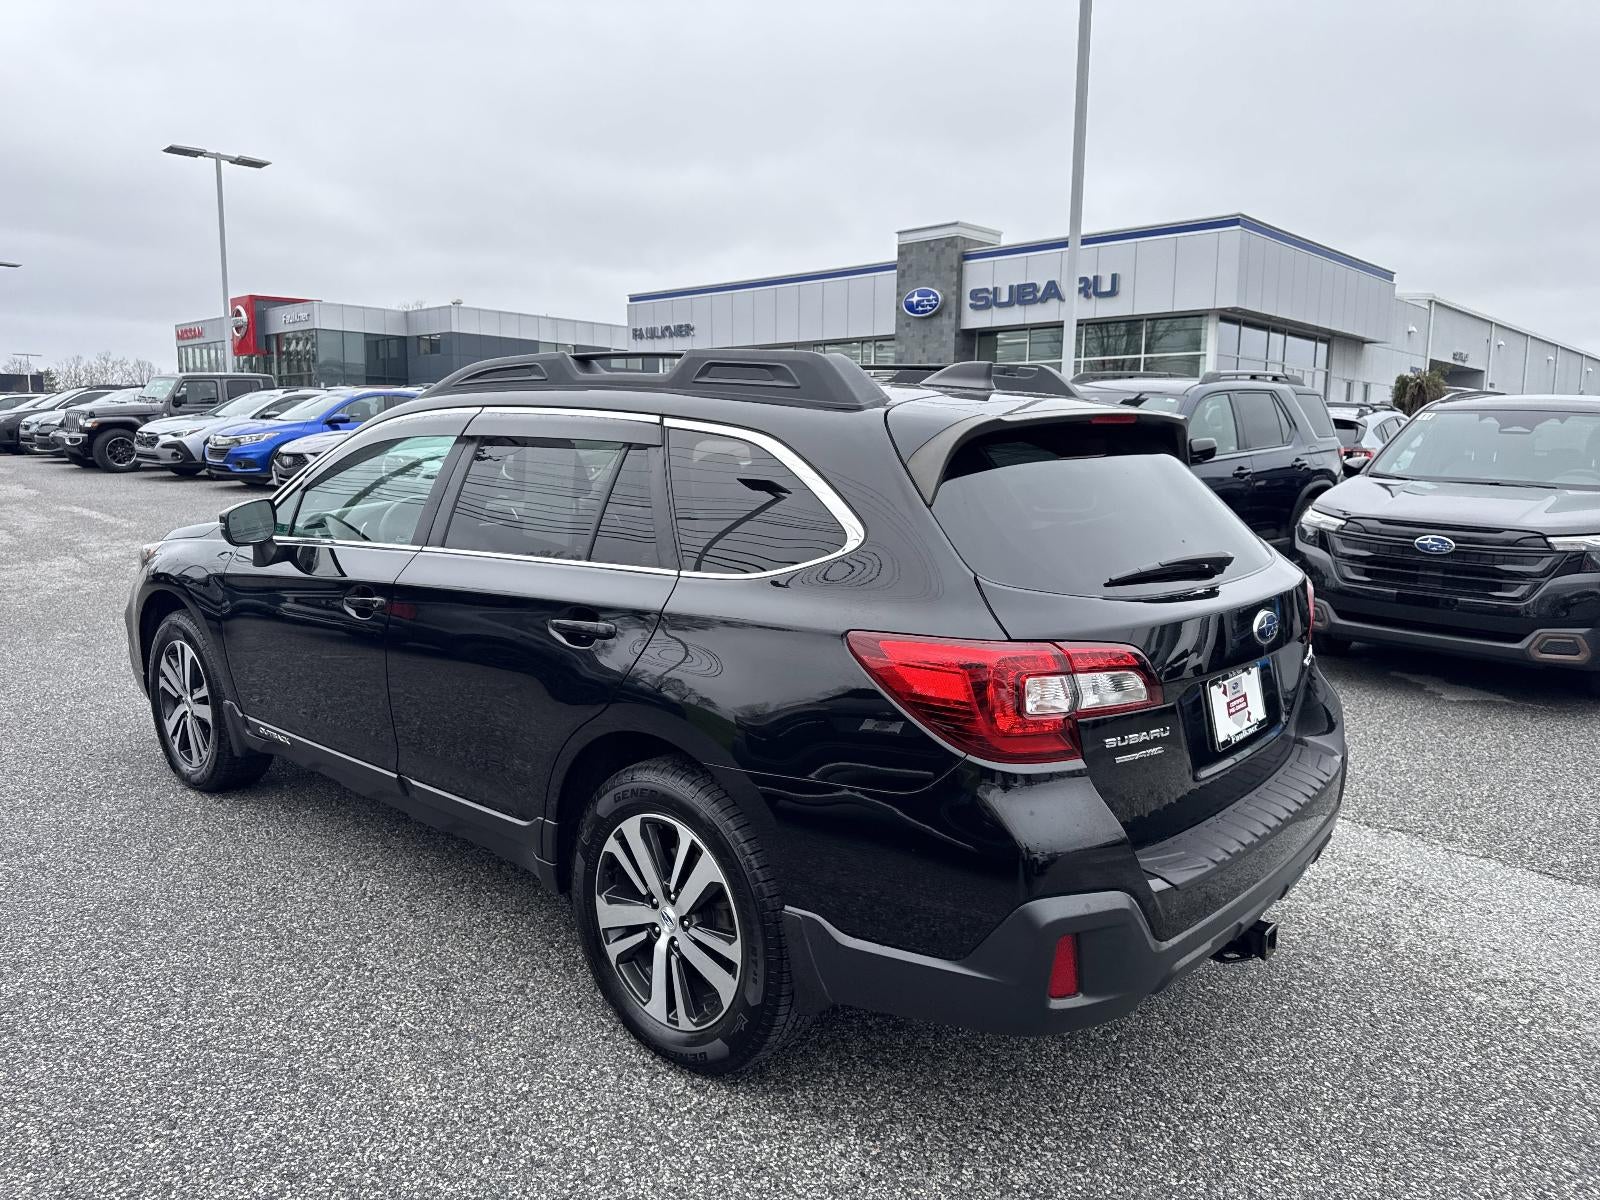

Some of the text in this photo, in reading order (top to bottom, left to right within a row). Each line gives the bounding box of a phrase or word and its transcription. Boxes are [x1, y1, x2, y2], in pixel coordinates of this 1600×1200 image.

[969, 273, 1121, 311] SUBARU
[176, 326, 203, 340] NISSAN
[631, 323, 696, 341] FAULKNER
[259, 726, 291, 745] OUTBACK
[1104, 726, 1170, 749] SUBARU
